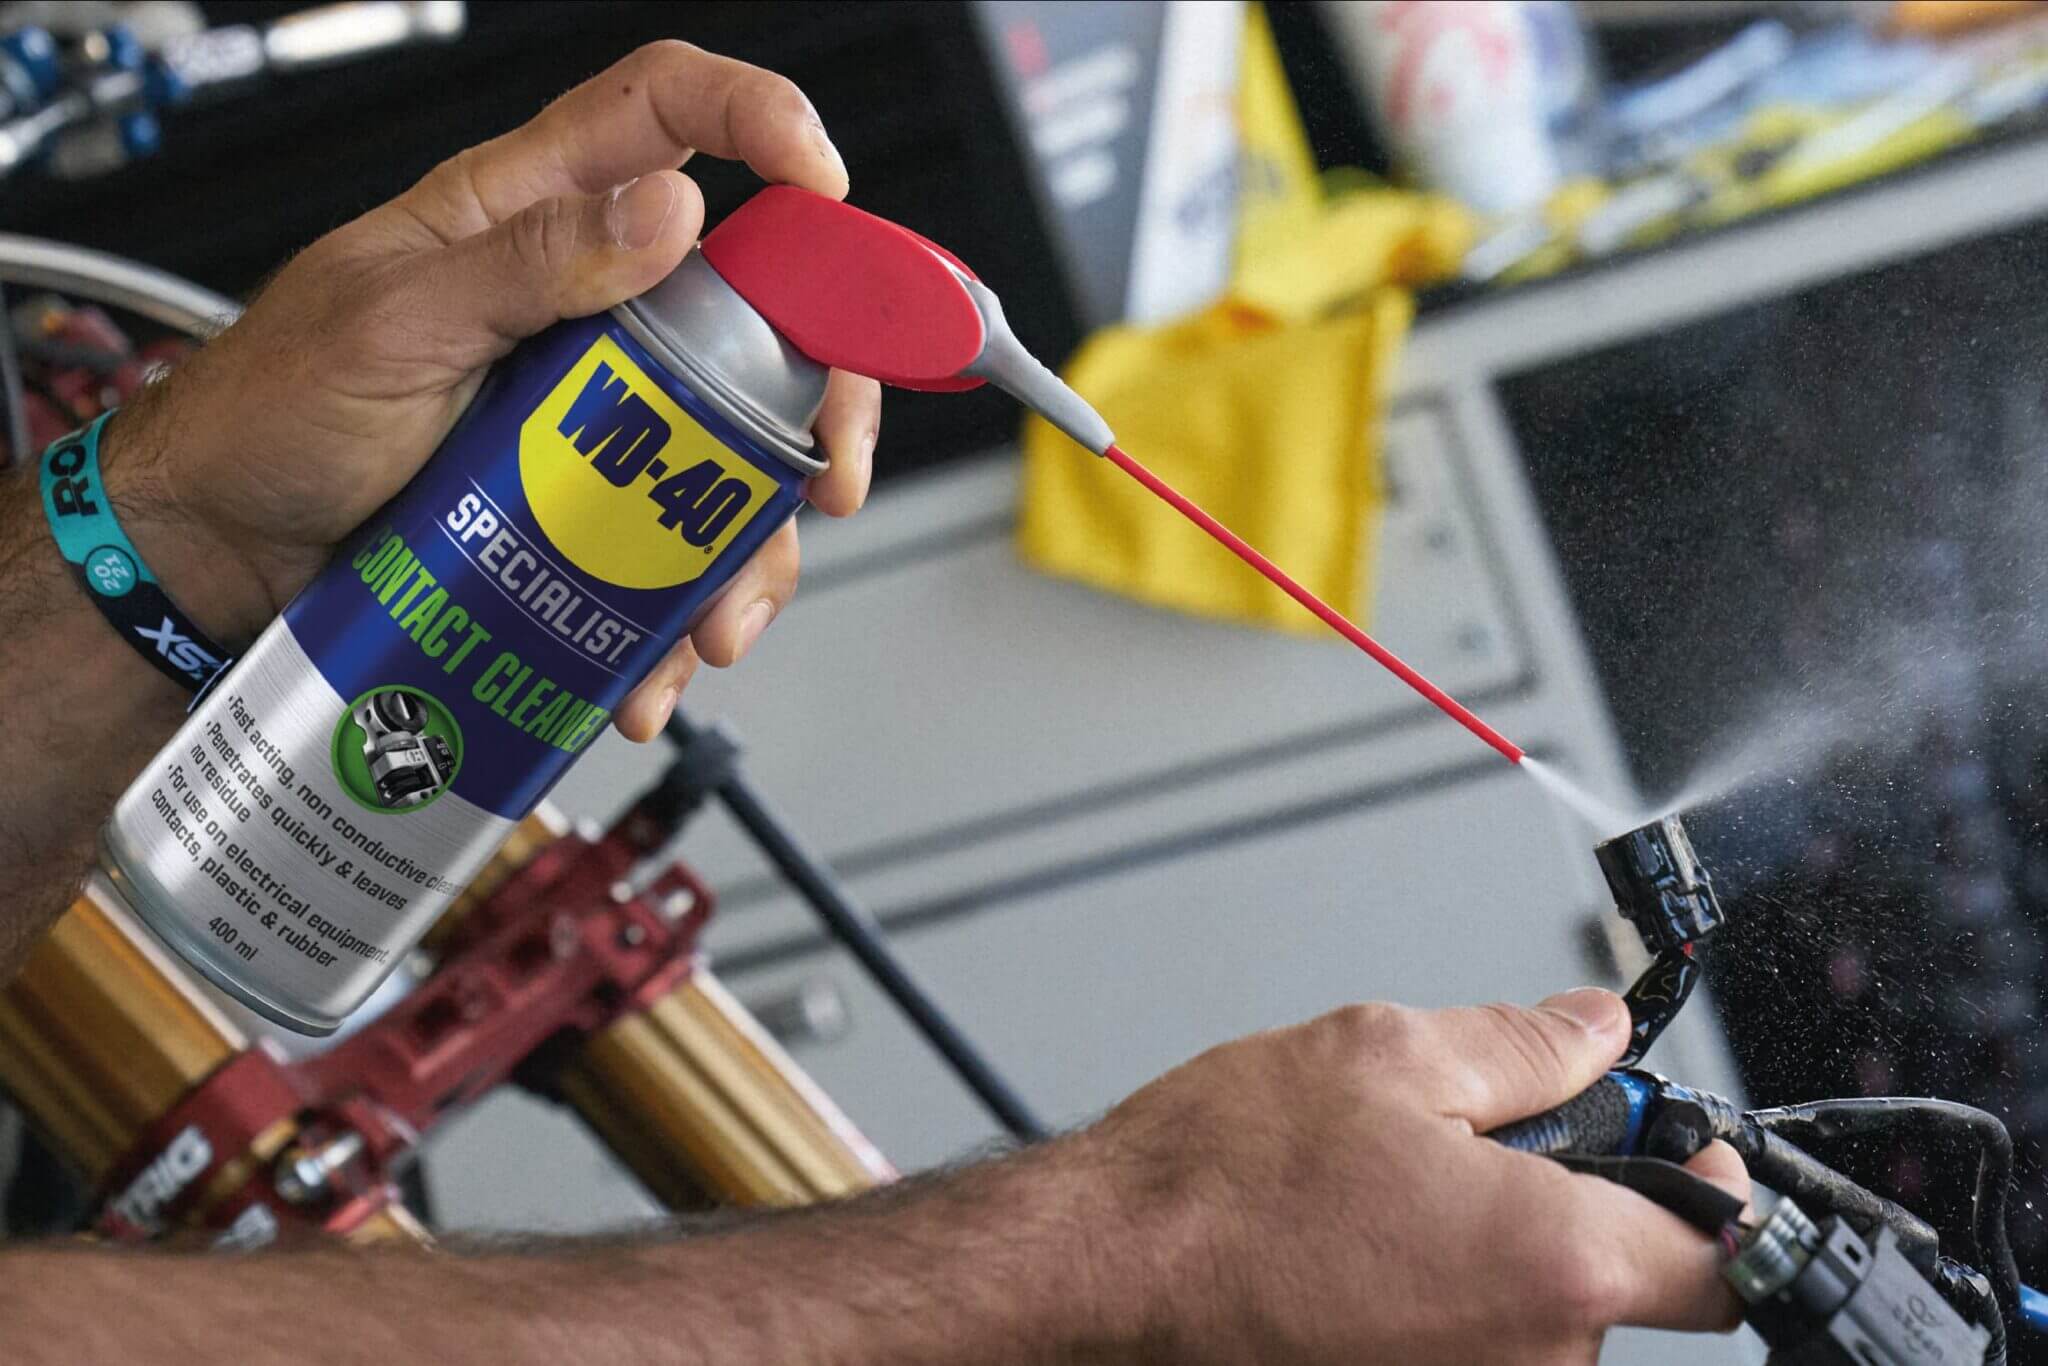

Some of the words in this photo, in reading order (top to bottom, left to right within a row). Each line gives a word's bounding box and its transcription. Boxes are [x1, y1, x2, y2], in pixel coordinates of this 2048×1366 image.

[49, 444, 98, 517] RO
[557, 360, 752, 547] WD-40
[94, 566, 121, 590] 20
[104, 554, 130, 579] 21
[352, 526, 492, 674] CONTACT
[471, 652, 610, 752] CLEANE
[447, 493, 640, 663] SPECIALIST
[134, 616, 225, 681] XS
[169, 766, 187, 792] For
[182, 790, 208, 823] use
[205, 820, 228, 846] on
[225, 842, 311, 918] electrical
[190, 744, 206, 765] no
[201, 761, 251, 823] residue
[207, 722, 273, 809] Penetrates
[271, 807, 337, 867] quickly
[335, 860, 353, 878] &
[352, 870, 407, 910] leaves
[229, 697, 256, 733] Fast
[249, 729, 295, 789] acting,
[296, 784, 332, 820] non
[332, 817, 427, 883] conductive
[152, 788, 200, 861] contacts,
[199, 856, 261, 916] plastic
[260, 911, 278, 930] &
[277, 925, 338, 967] rubber
[209, 916, 238, 944] 400
[234, 938, 259, 961] ml
